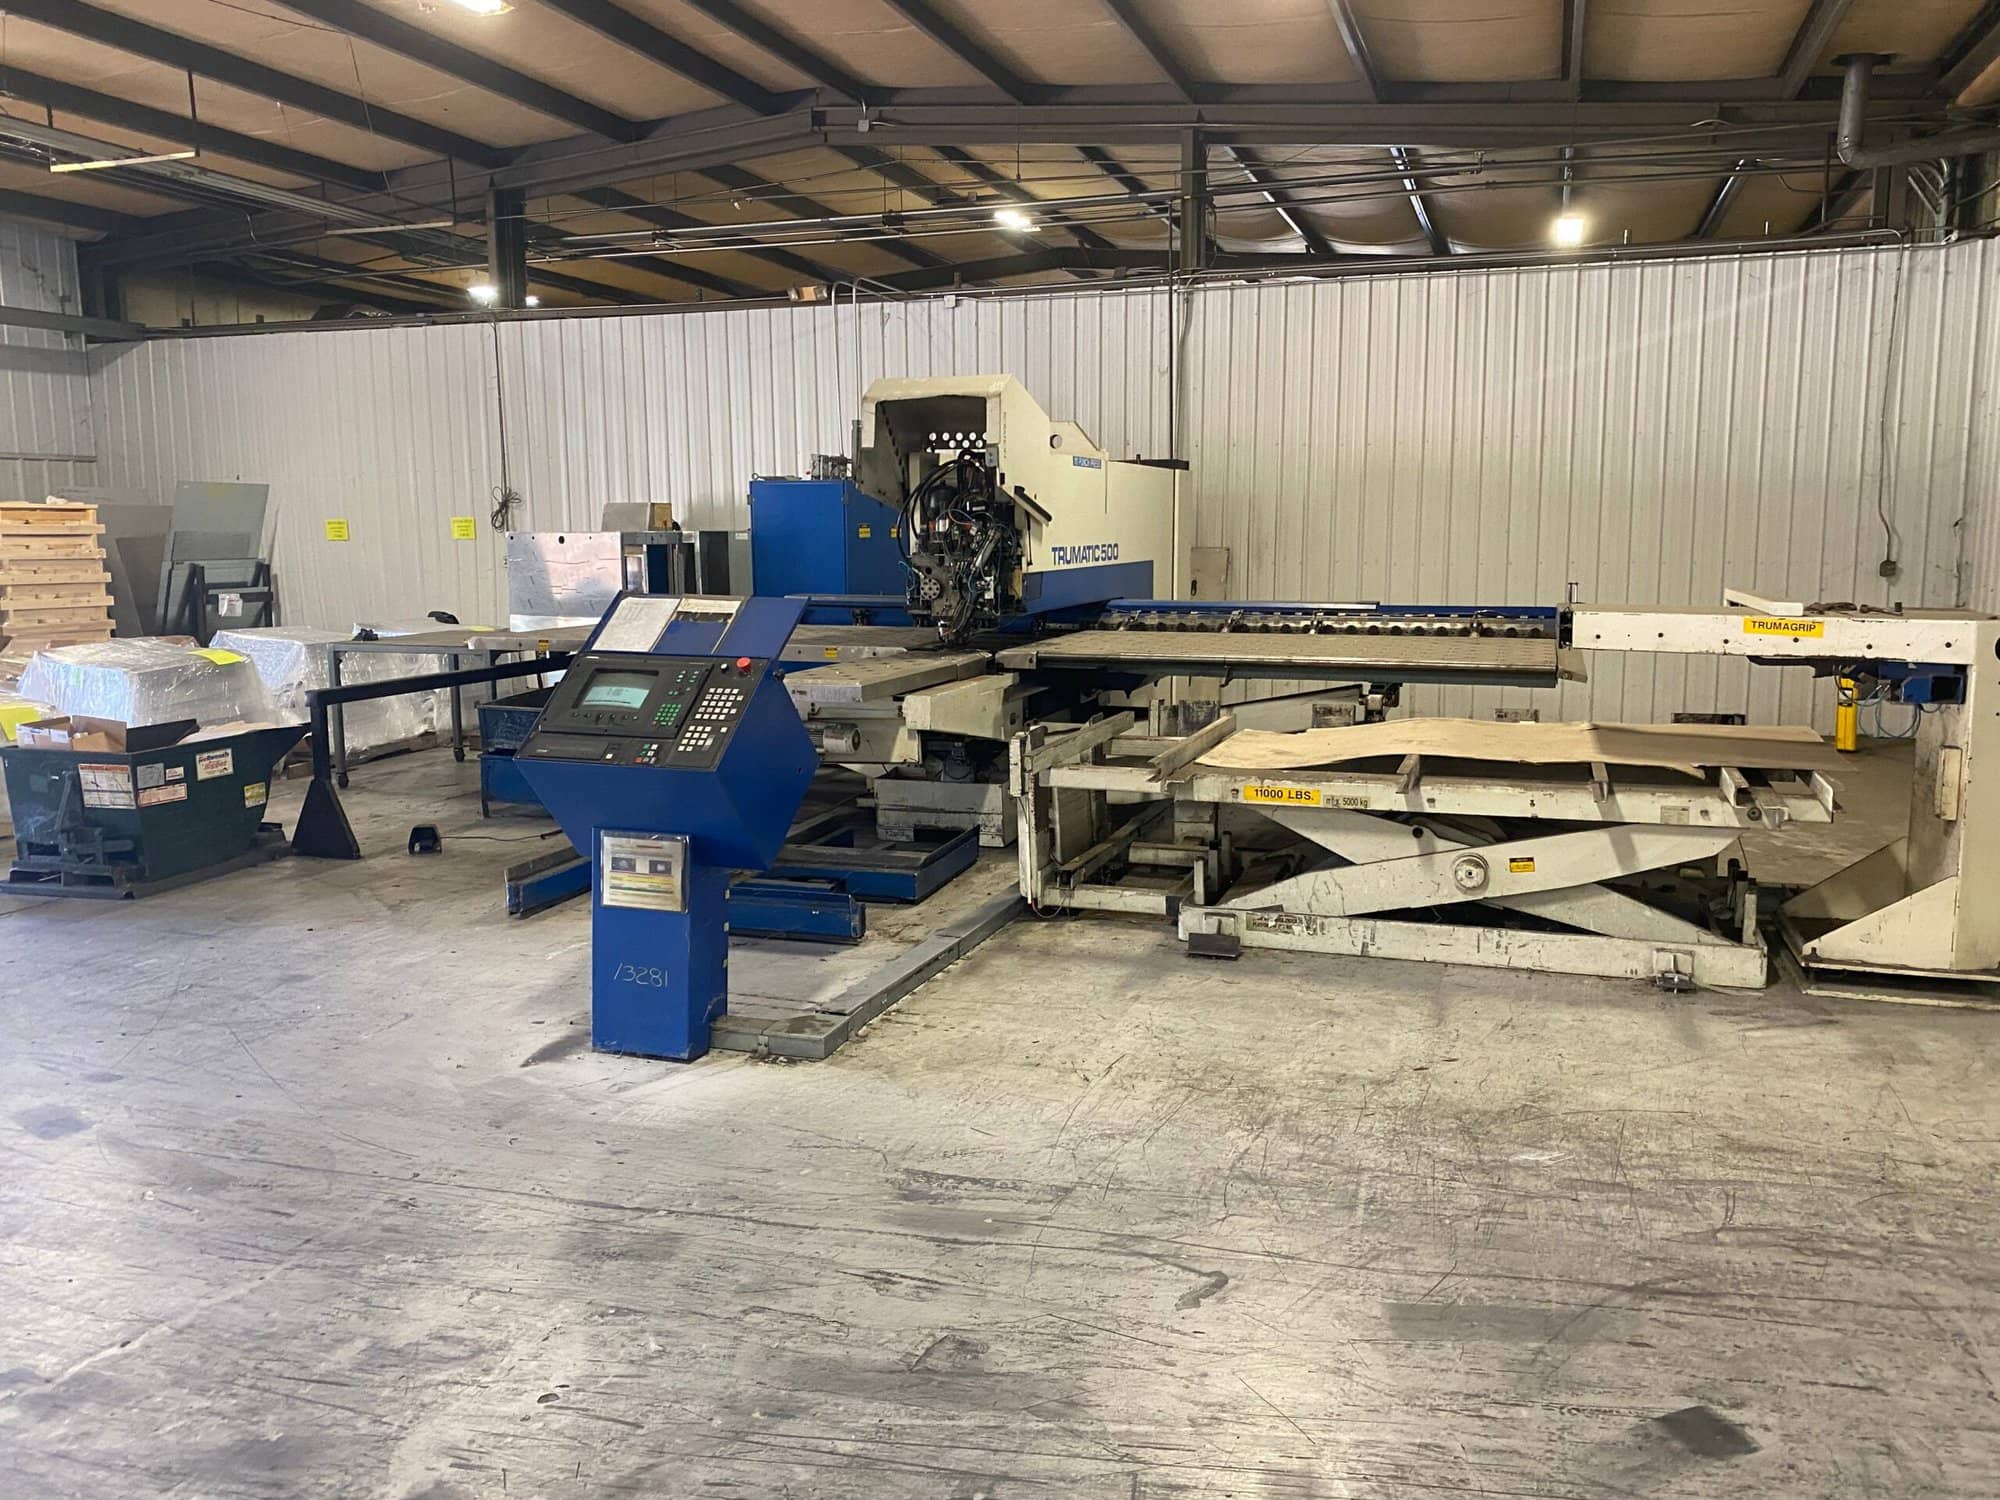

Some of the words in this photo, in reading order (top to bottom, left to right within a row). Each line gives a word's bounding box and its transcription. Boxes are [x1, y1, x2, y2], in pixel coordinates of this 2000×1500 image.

[1751, 620, 1817, 632] TRUMAGRIP
[1254, 788, 1284, 798] 11000
[1288, 789, 1314, 801] LBS.
[1342, 797, 1359, 806] 5000
[1359, 797, 1368, 808] kg
[614, 962, 668, 988] 13281
